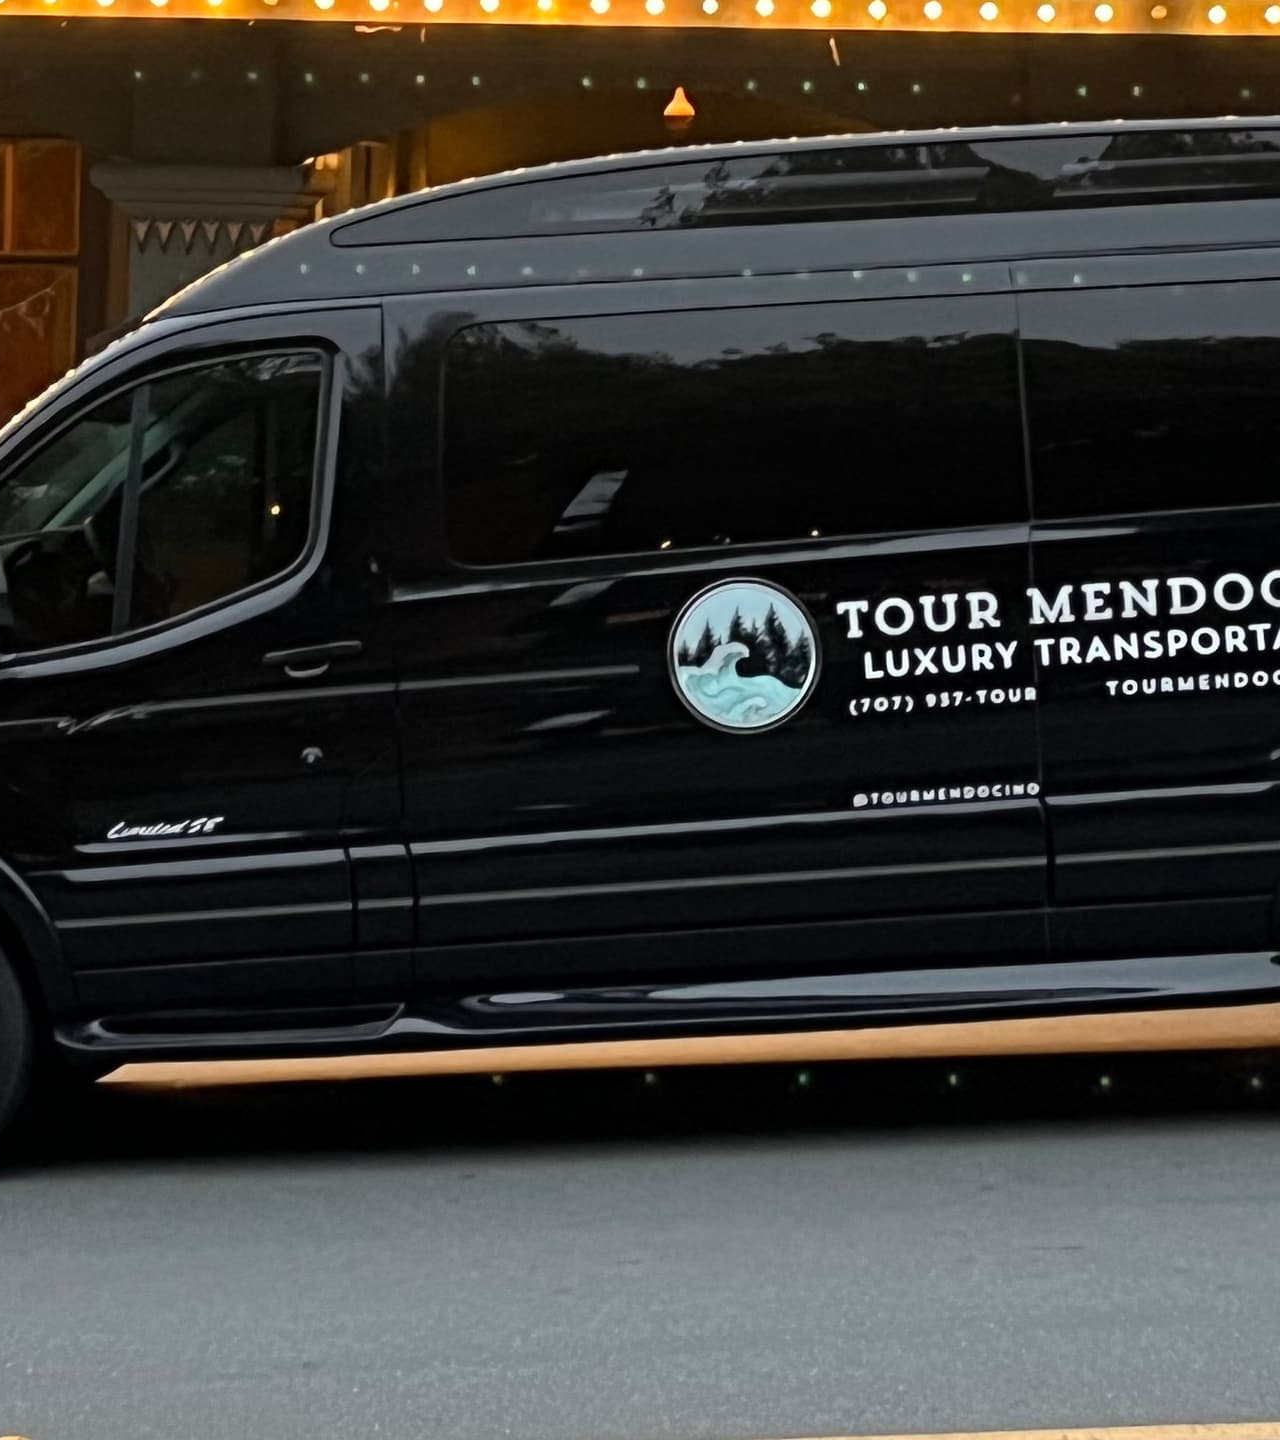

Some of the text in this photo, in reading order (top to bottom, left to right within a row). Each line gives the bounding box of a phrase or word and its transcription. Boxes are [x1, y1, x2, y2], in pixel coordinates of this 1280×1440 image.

[836, 591, 1002, 639] TOUR
[863, 640, 1018, 680] LUXURY
[849, 695, 915, 717] (707)
